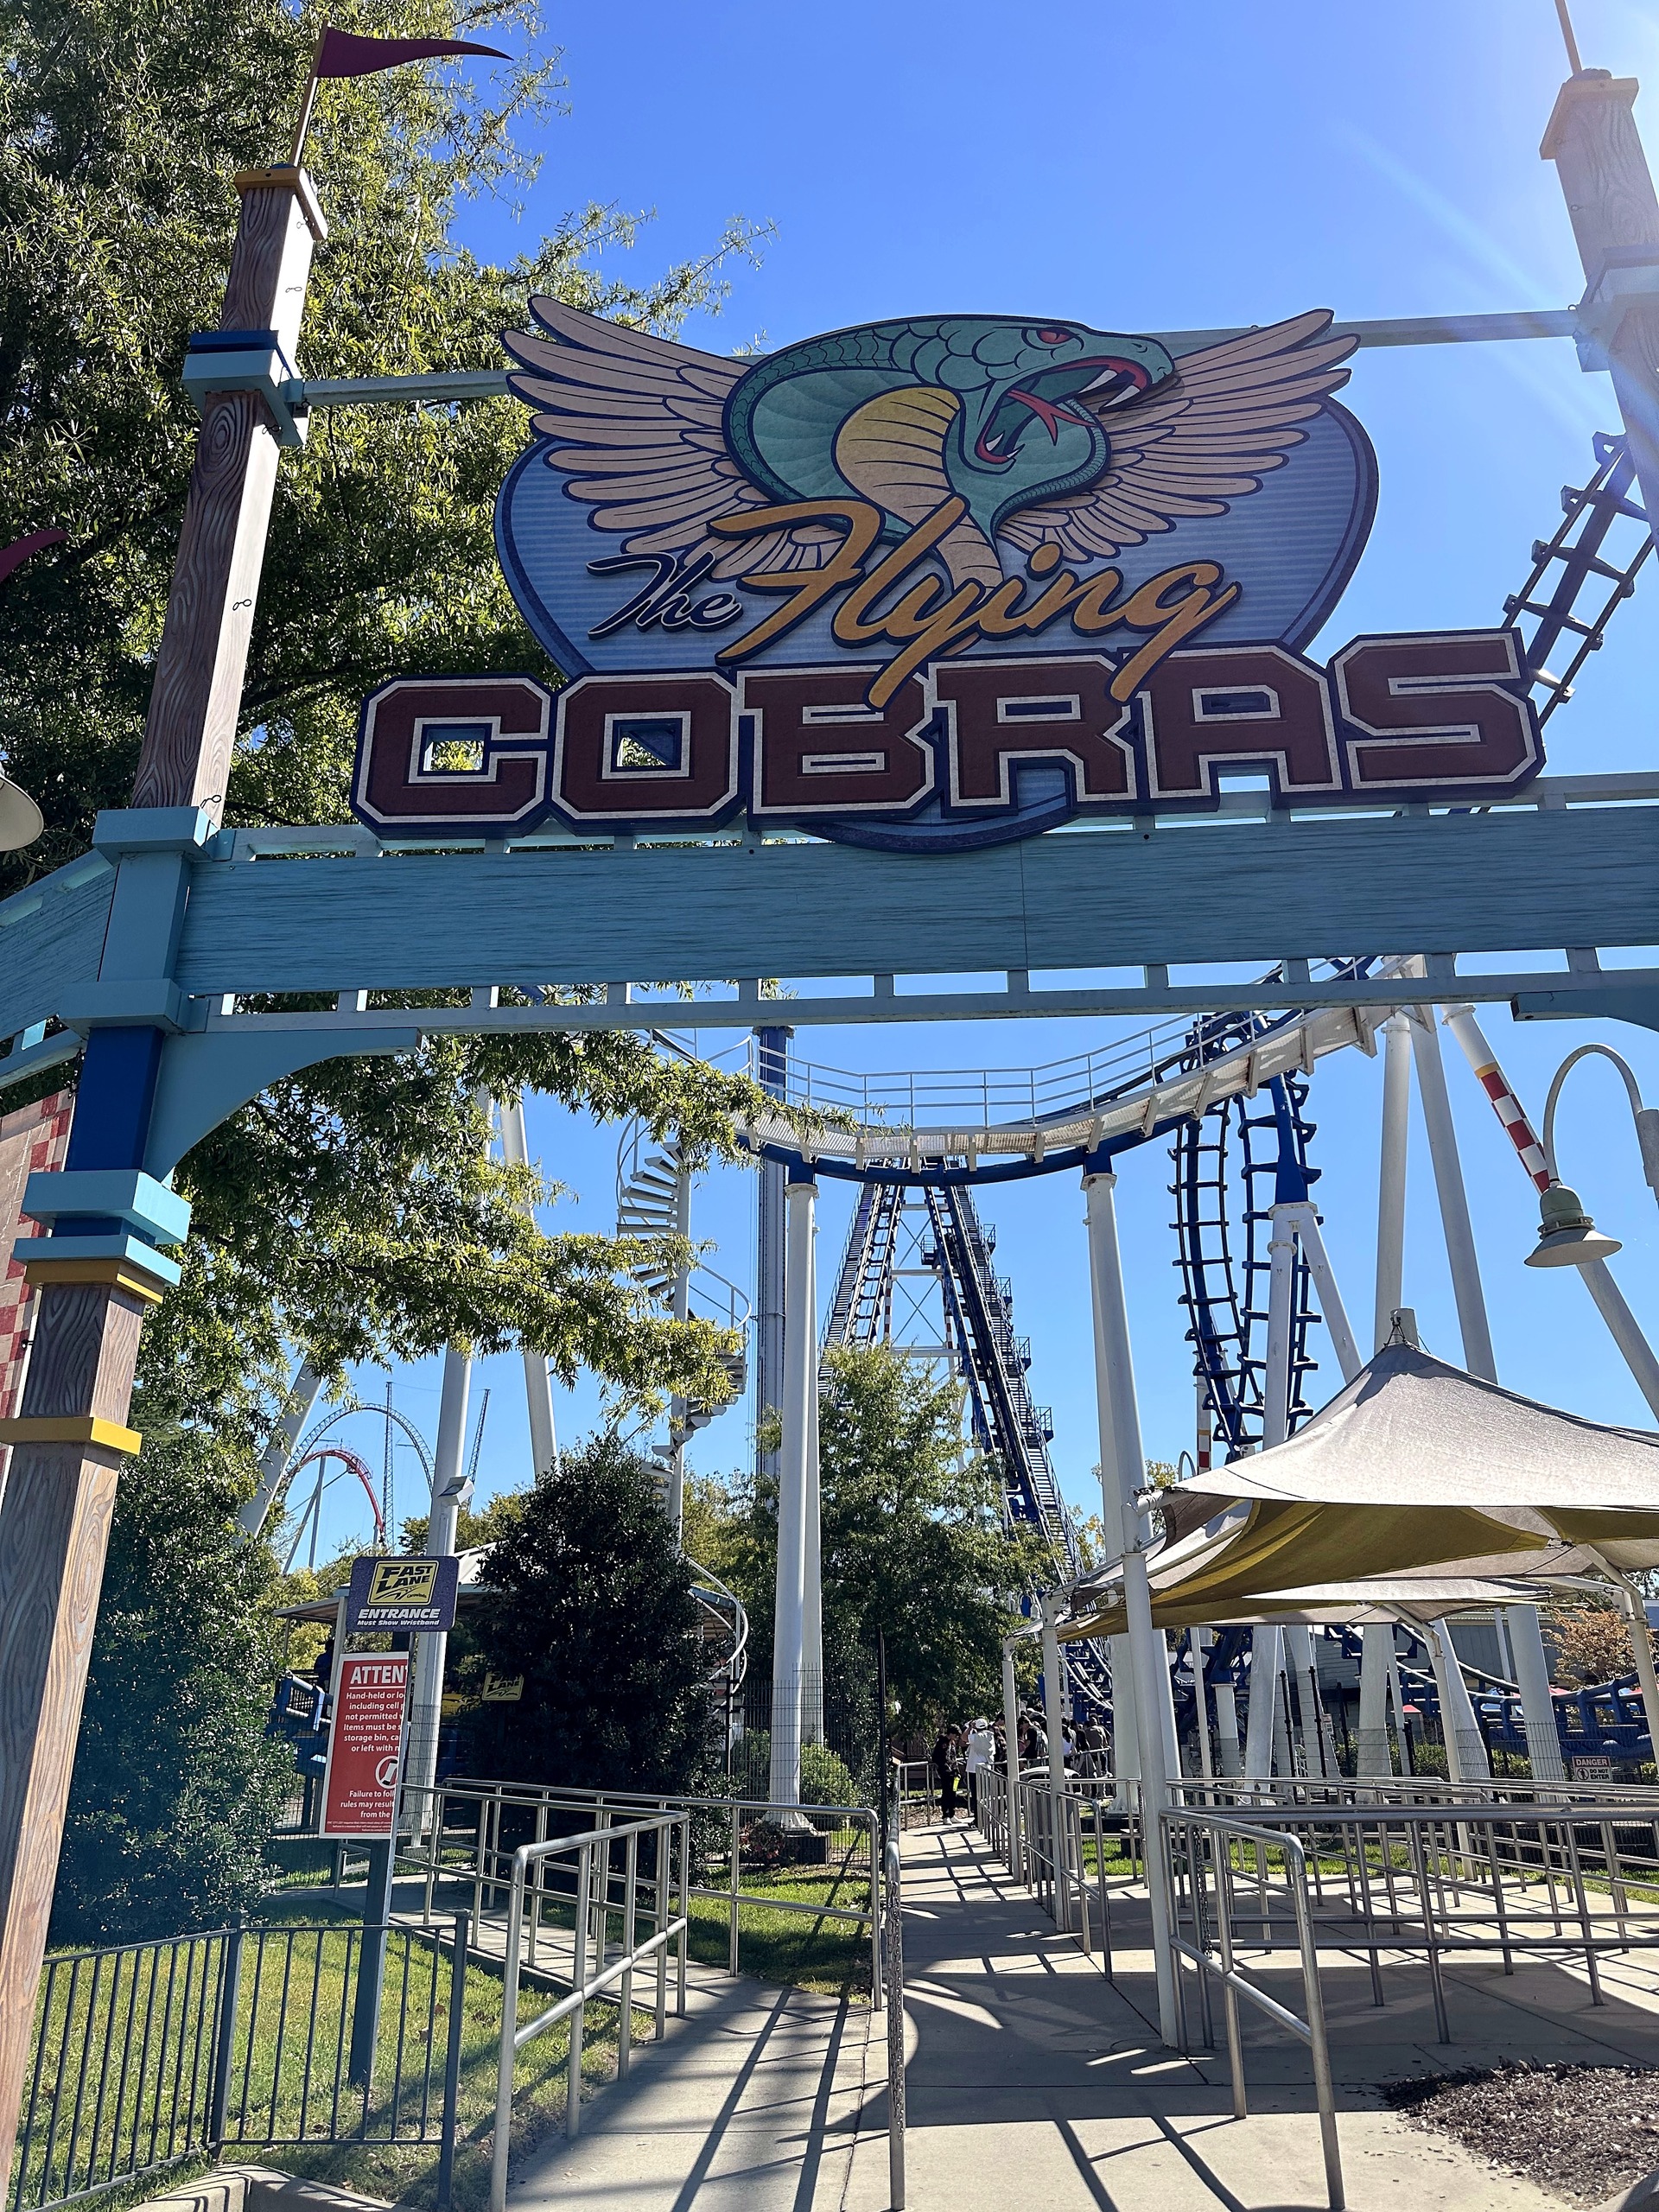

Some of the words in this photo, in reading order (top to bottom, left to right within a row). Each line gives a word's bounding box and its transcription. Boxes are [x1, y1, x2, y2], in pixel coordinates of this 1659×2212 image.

[587, 550, 745, 639] The
[706, 496, 1243, 710] Flying
[353, 628, 1544, 835] COBRAS
[381, 1566, 434, 1580] FAST
[376, 1575, 430, 1594] LANE
[358, 1608, 441, 1619] ENTRANCE
[349, 1702, 385, 1711] including
[359, 1712, 397, 1721] permitted
[374, 1733, 389, 1742] bin,
